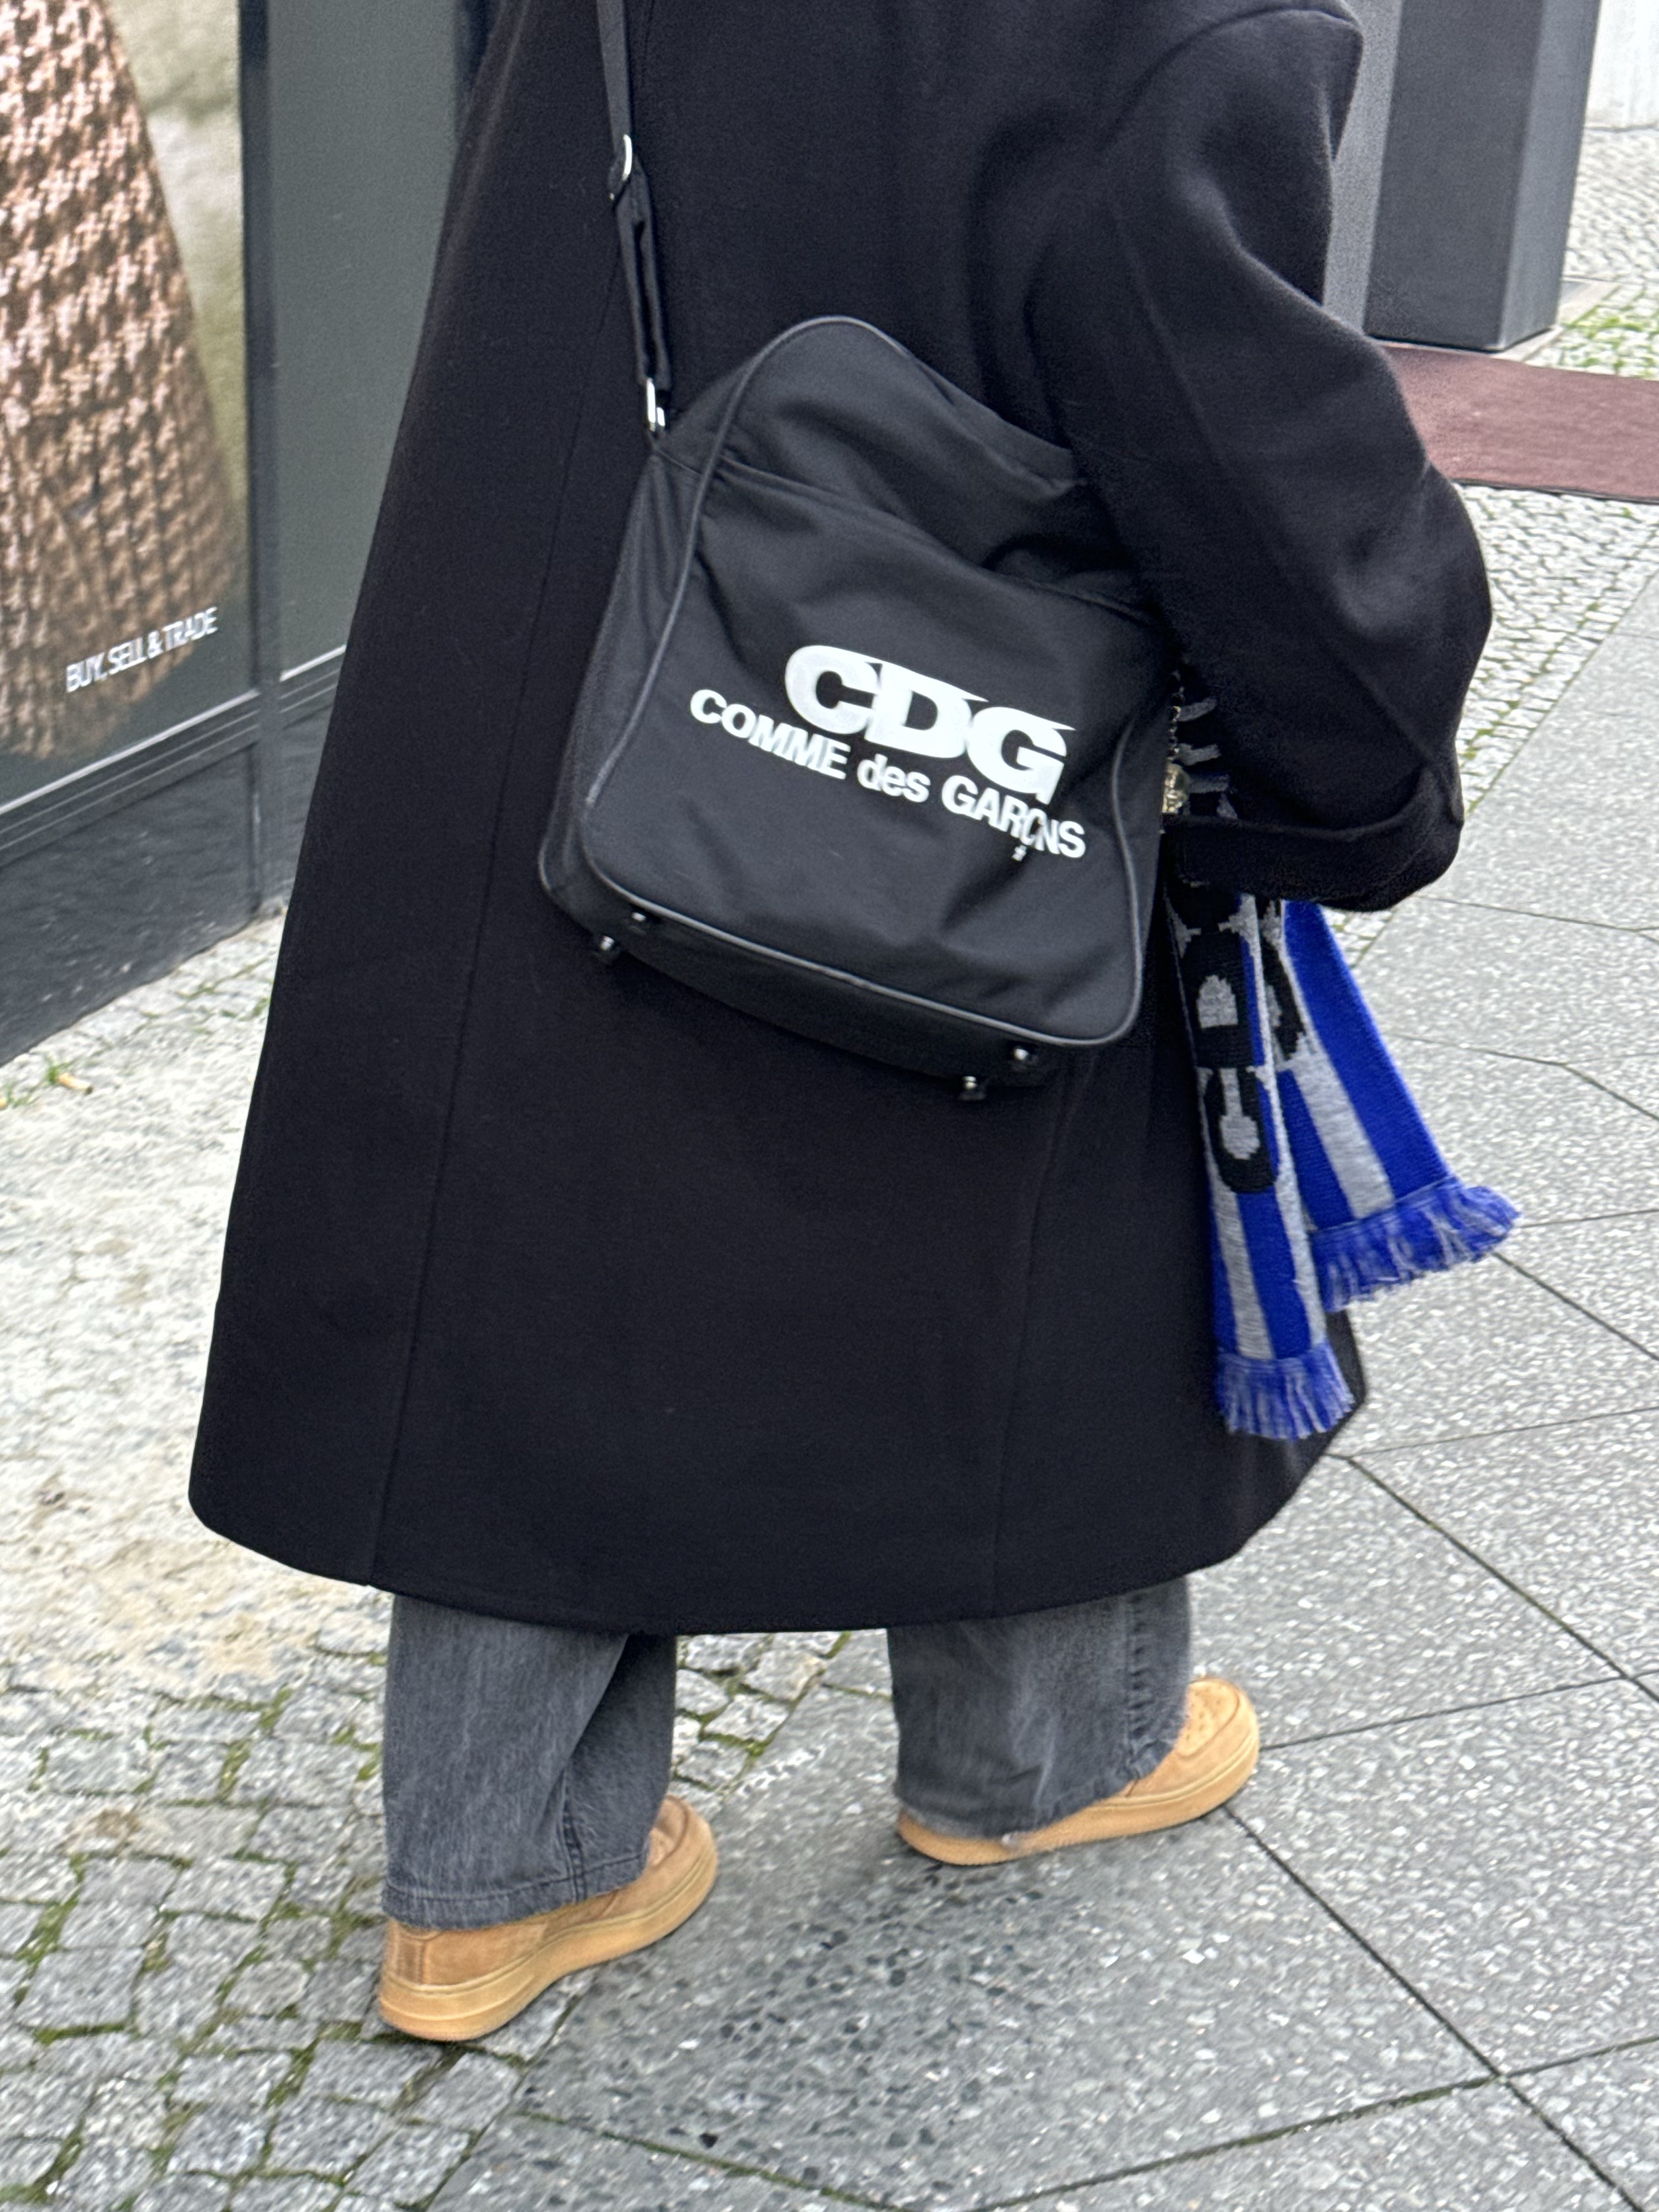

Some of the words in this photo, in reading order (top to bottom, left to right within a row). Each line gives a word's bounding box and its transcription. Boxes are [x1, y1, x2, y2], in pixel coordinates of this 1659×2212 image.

[108, 637, 147, 675] SELL
[147, 630, 164, 660] &
[162, 606, 218, 651] TRADE
[690, 689, 851, 780] COMME
[857, 754, 930, 803] des
[784, 645, 1075, 805] CDG
